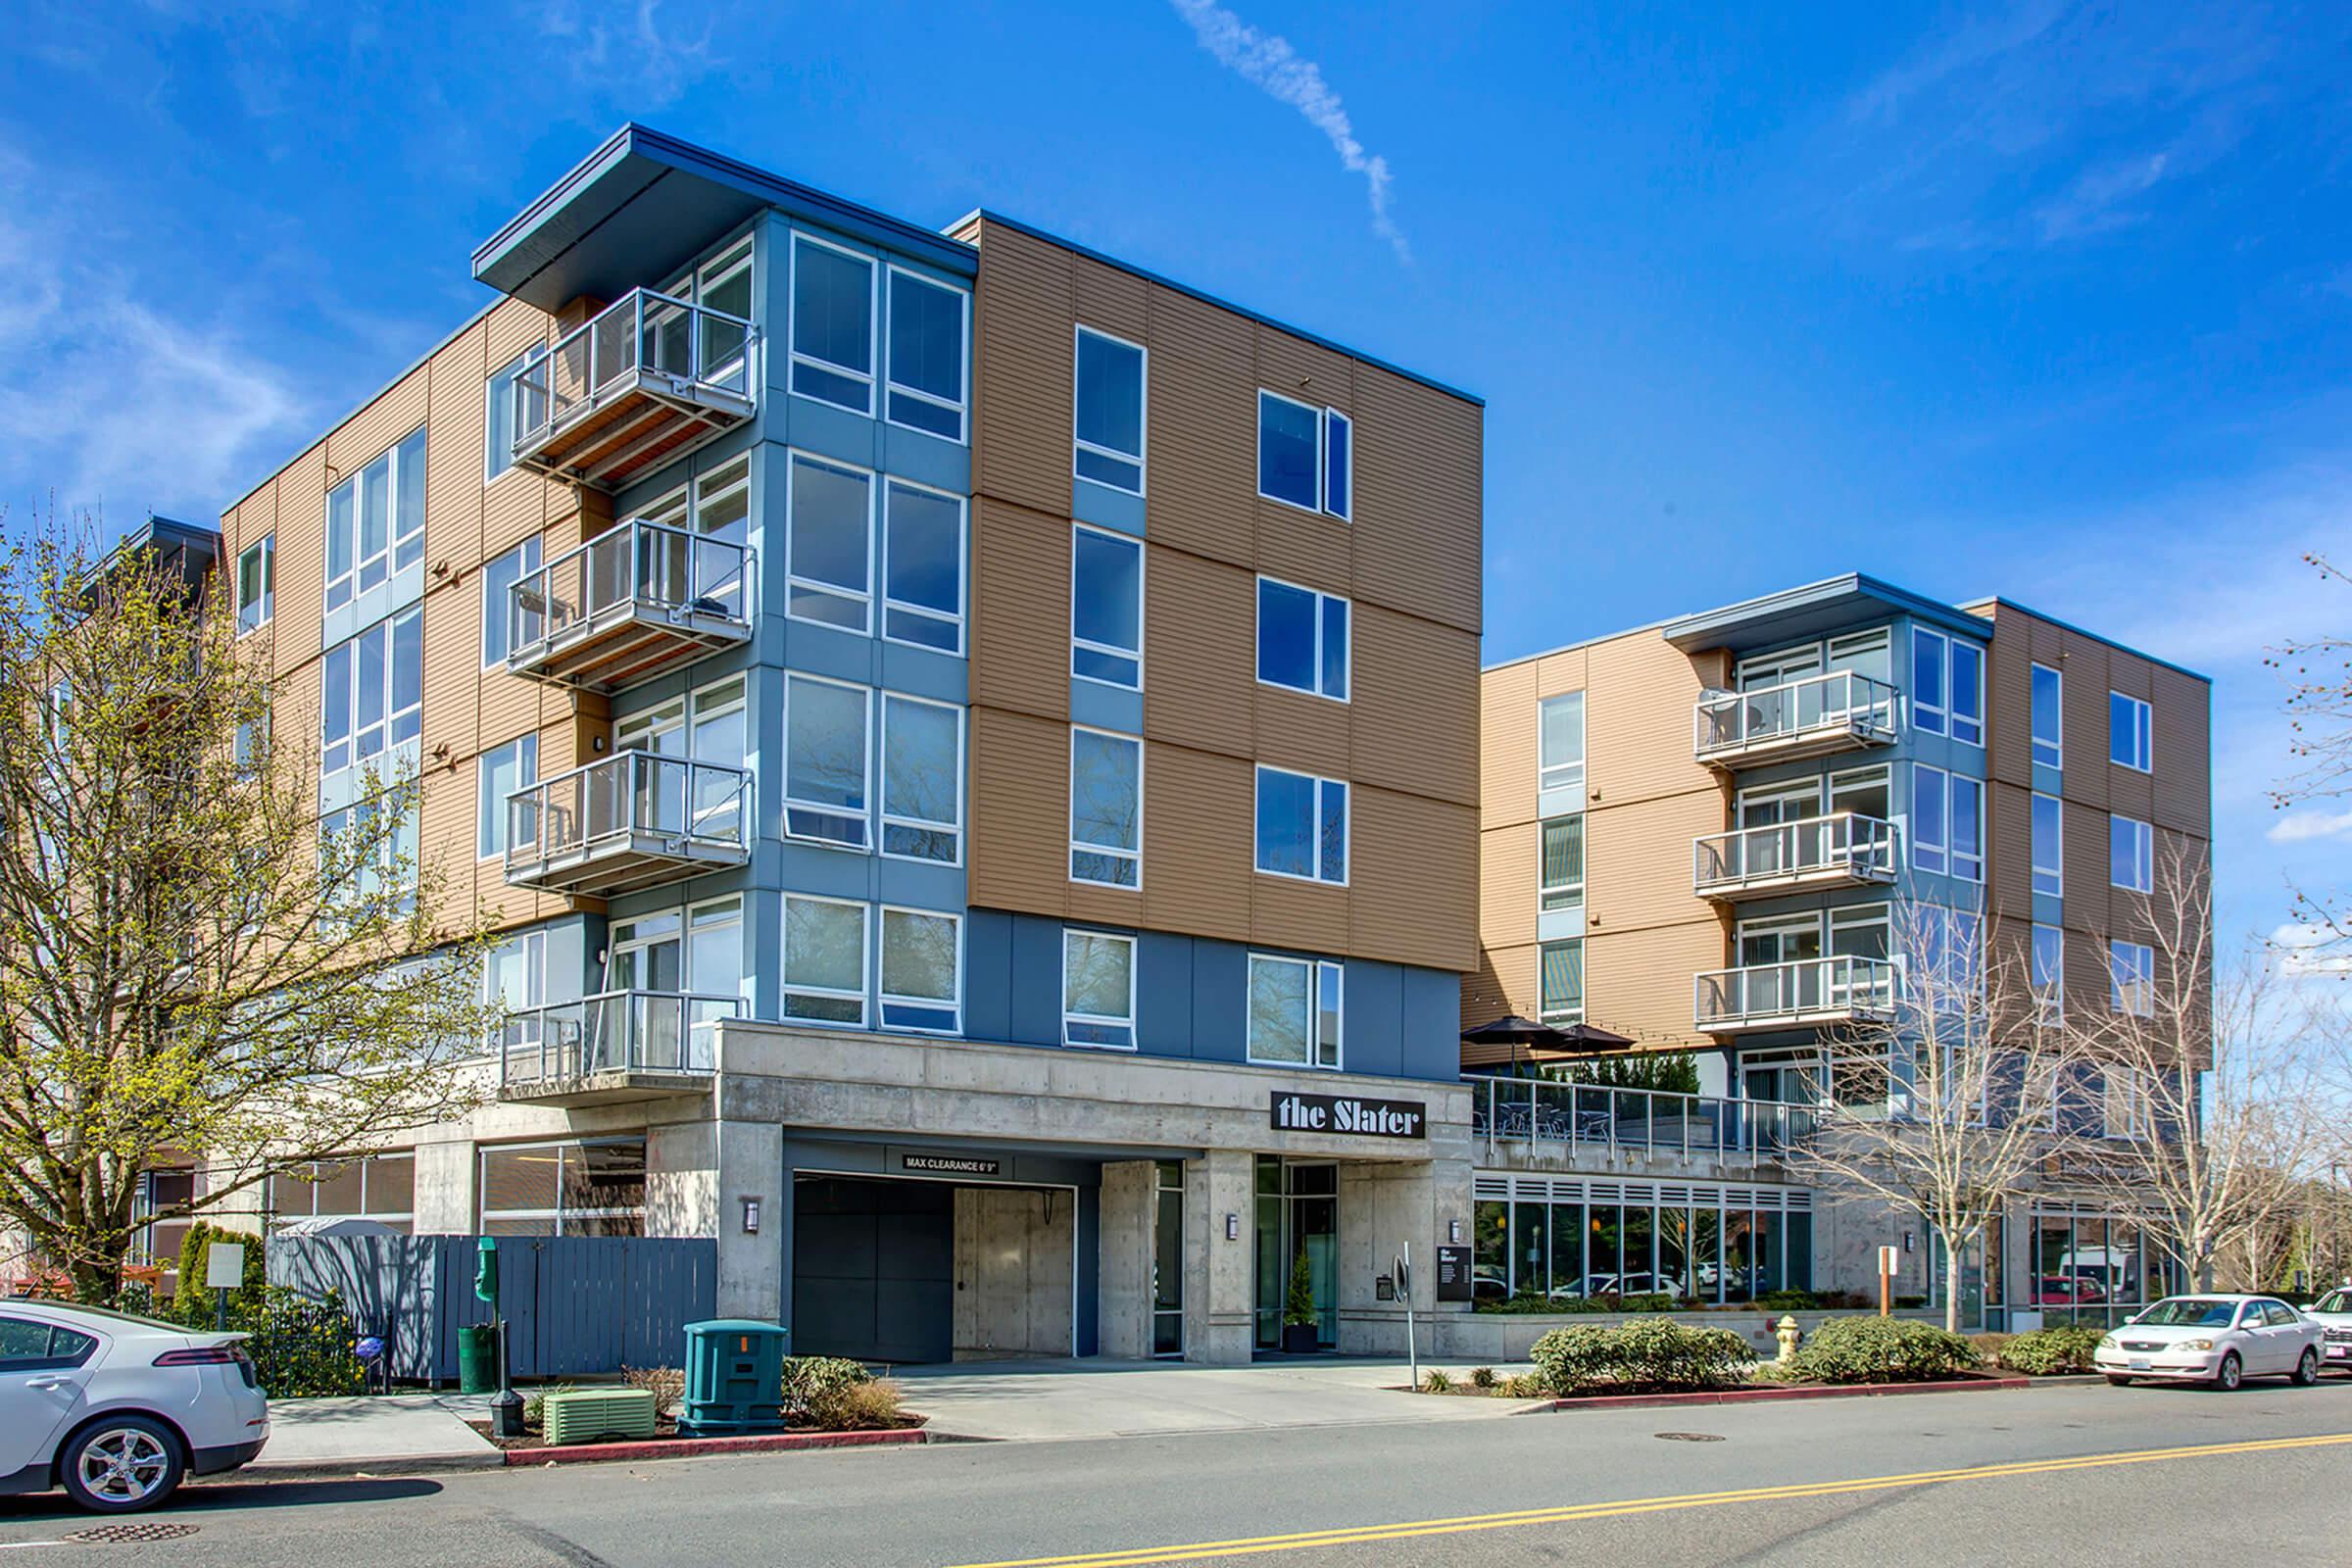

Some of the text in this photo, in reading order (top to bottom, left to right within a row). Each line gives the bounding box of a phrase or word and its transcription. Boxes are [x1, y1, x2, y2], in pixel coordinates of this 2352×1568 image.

[1278, 1097, 1419, 1135] the Slater
[906, 1157, 926, 1168] MAX
[927, 1158, 978, 1172] CLEARANCE
